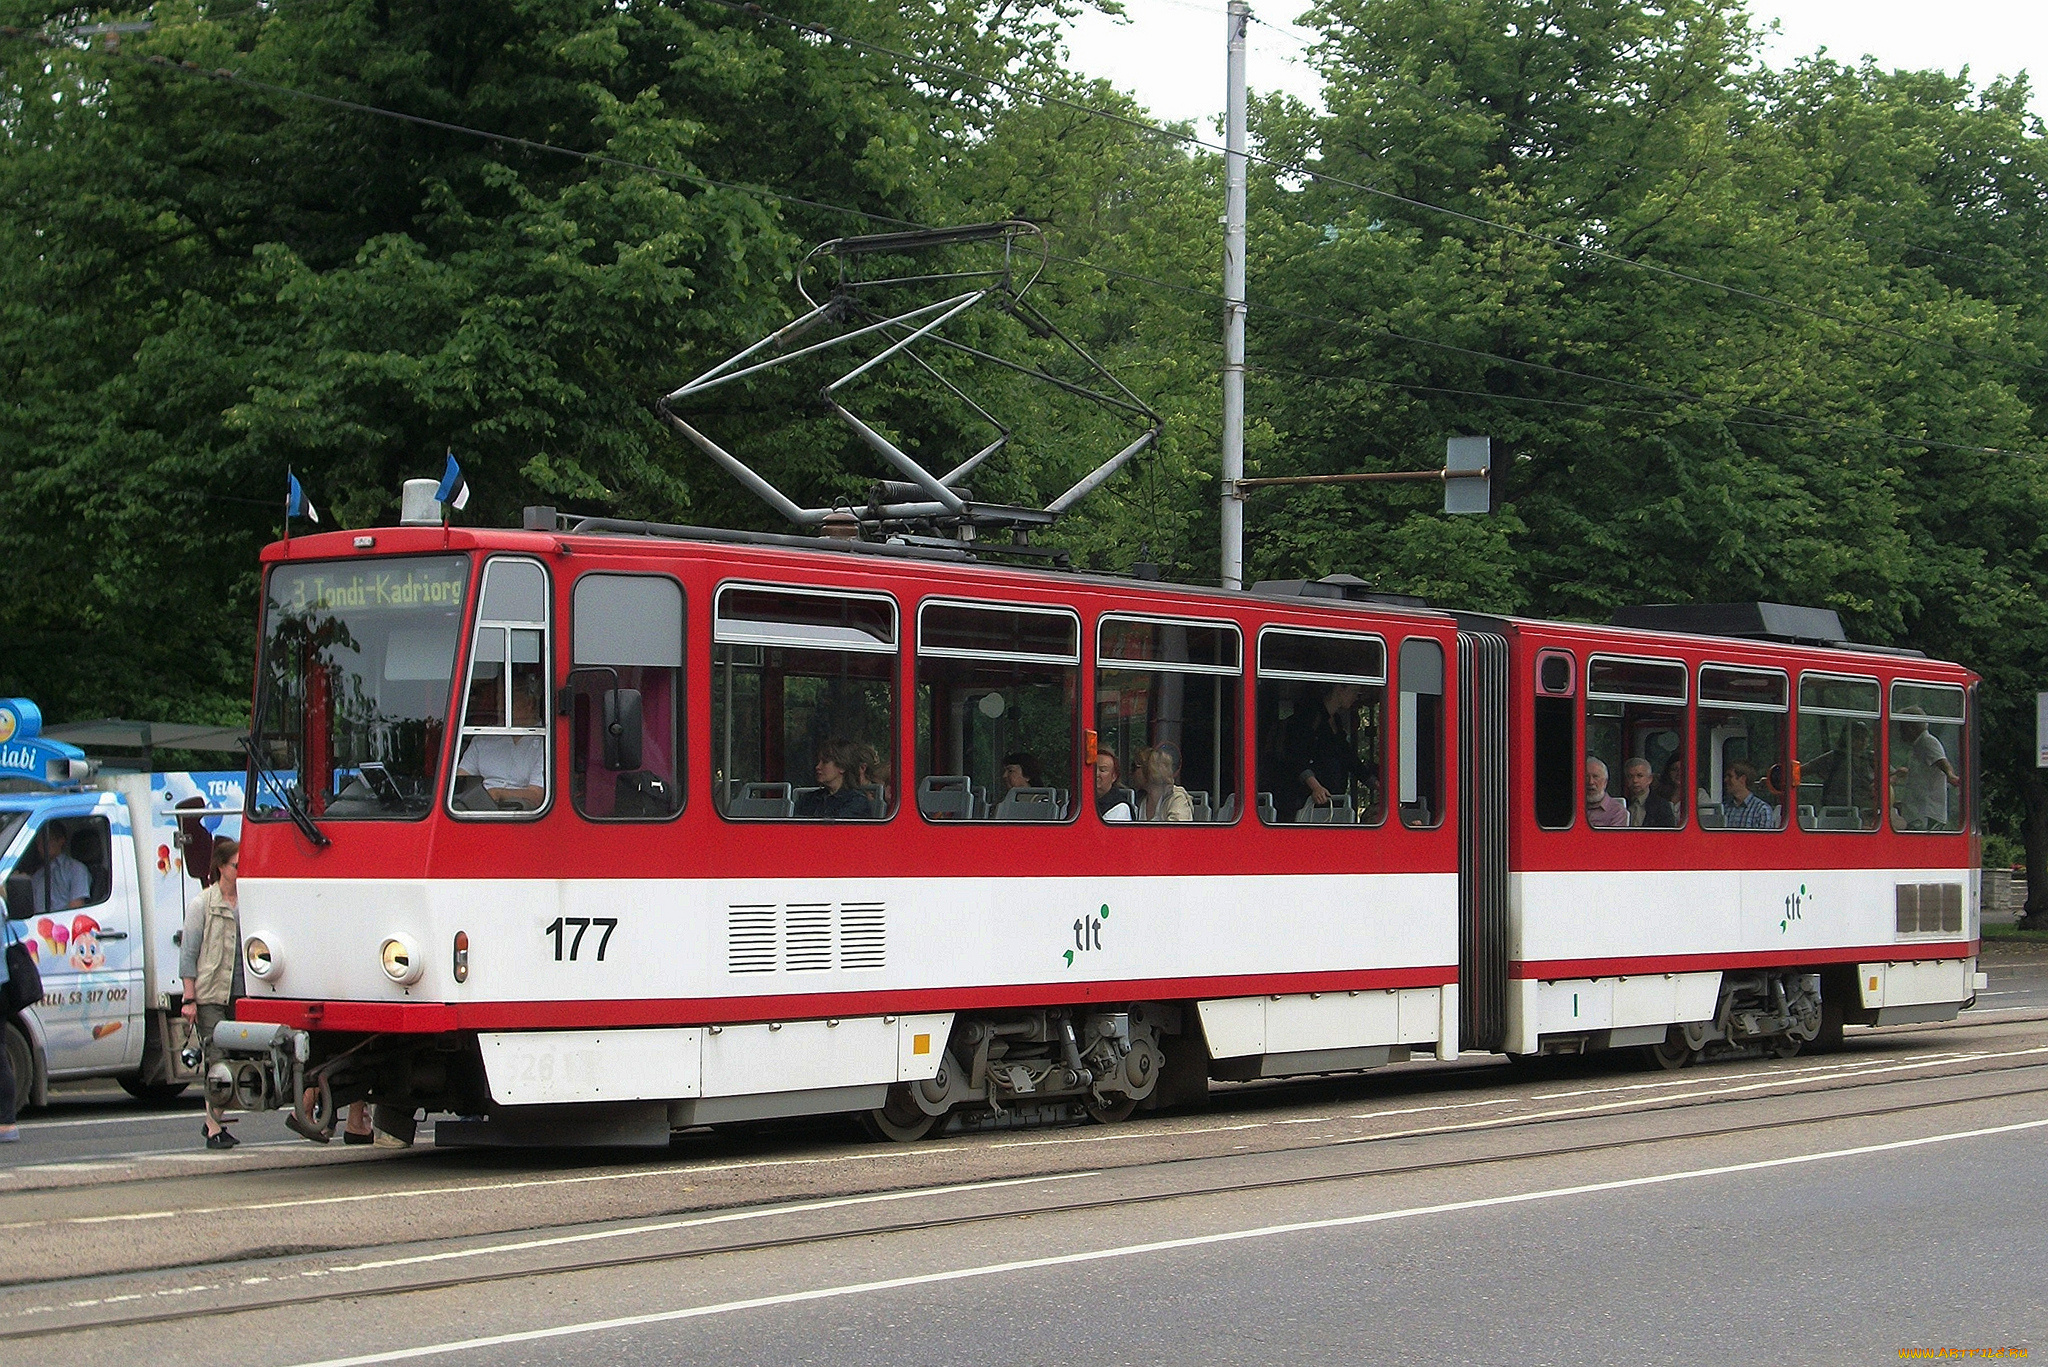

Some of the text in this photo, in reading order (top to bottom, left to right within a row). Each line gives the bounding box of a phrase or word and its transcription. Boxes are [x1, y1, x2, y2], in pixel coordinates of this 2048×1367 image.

[293, 573, 462, 608] 3 Tondi-Kadriorg
[0, 743, 37, 772] iabi
[1785, 892, 1802, 920] tlt
[546, 917, 618, 962] 177
[1073, 914, 1102, 951] tlt
[69, 991, 82, 1005] 53
[86, 989, 104, 1004] 317
[106, 988, 128, 1002] 002
